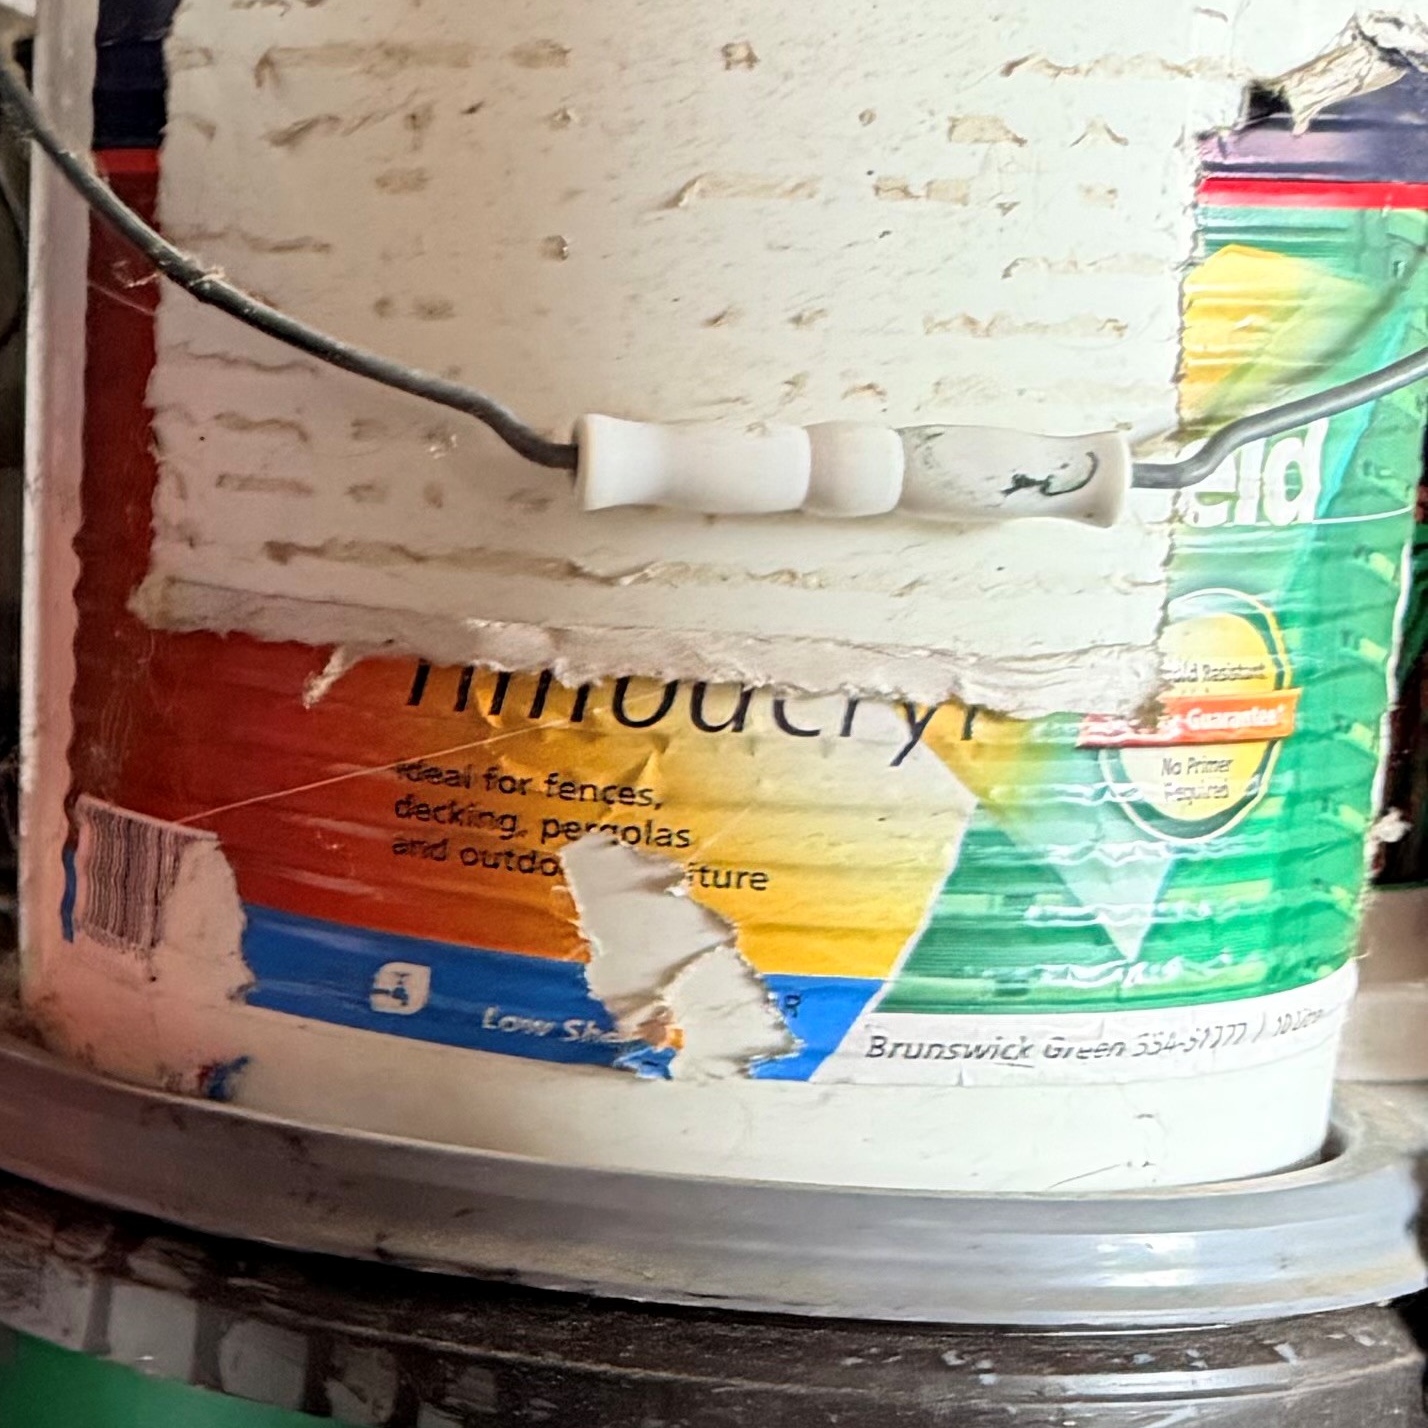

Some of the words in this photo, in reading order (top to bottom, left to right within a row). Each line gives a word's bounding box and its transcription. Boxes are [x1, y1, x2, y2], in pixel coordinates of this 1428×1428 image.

[483, 764, 534, 796] for
[543, 771, 663, 811] fences,
[540, 815, 693, 849] pergolas
[391, 835, 451, 862] and
[459, 844, 564, 877] outdo
[481, 1005, 550, 1035] Low
[864, 1034, 1036, 1062] Brunswick
[1042, 1037, 1127, 1060] Green
